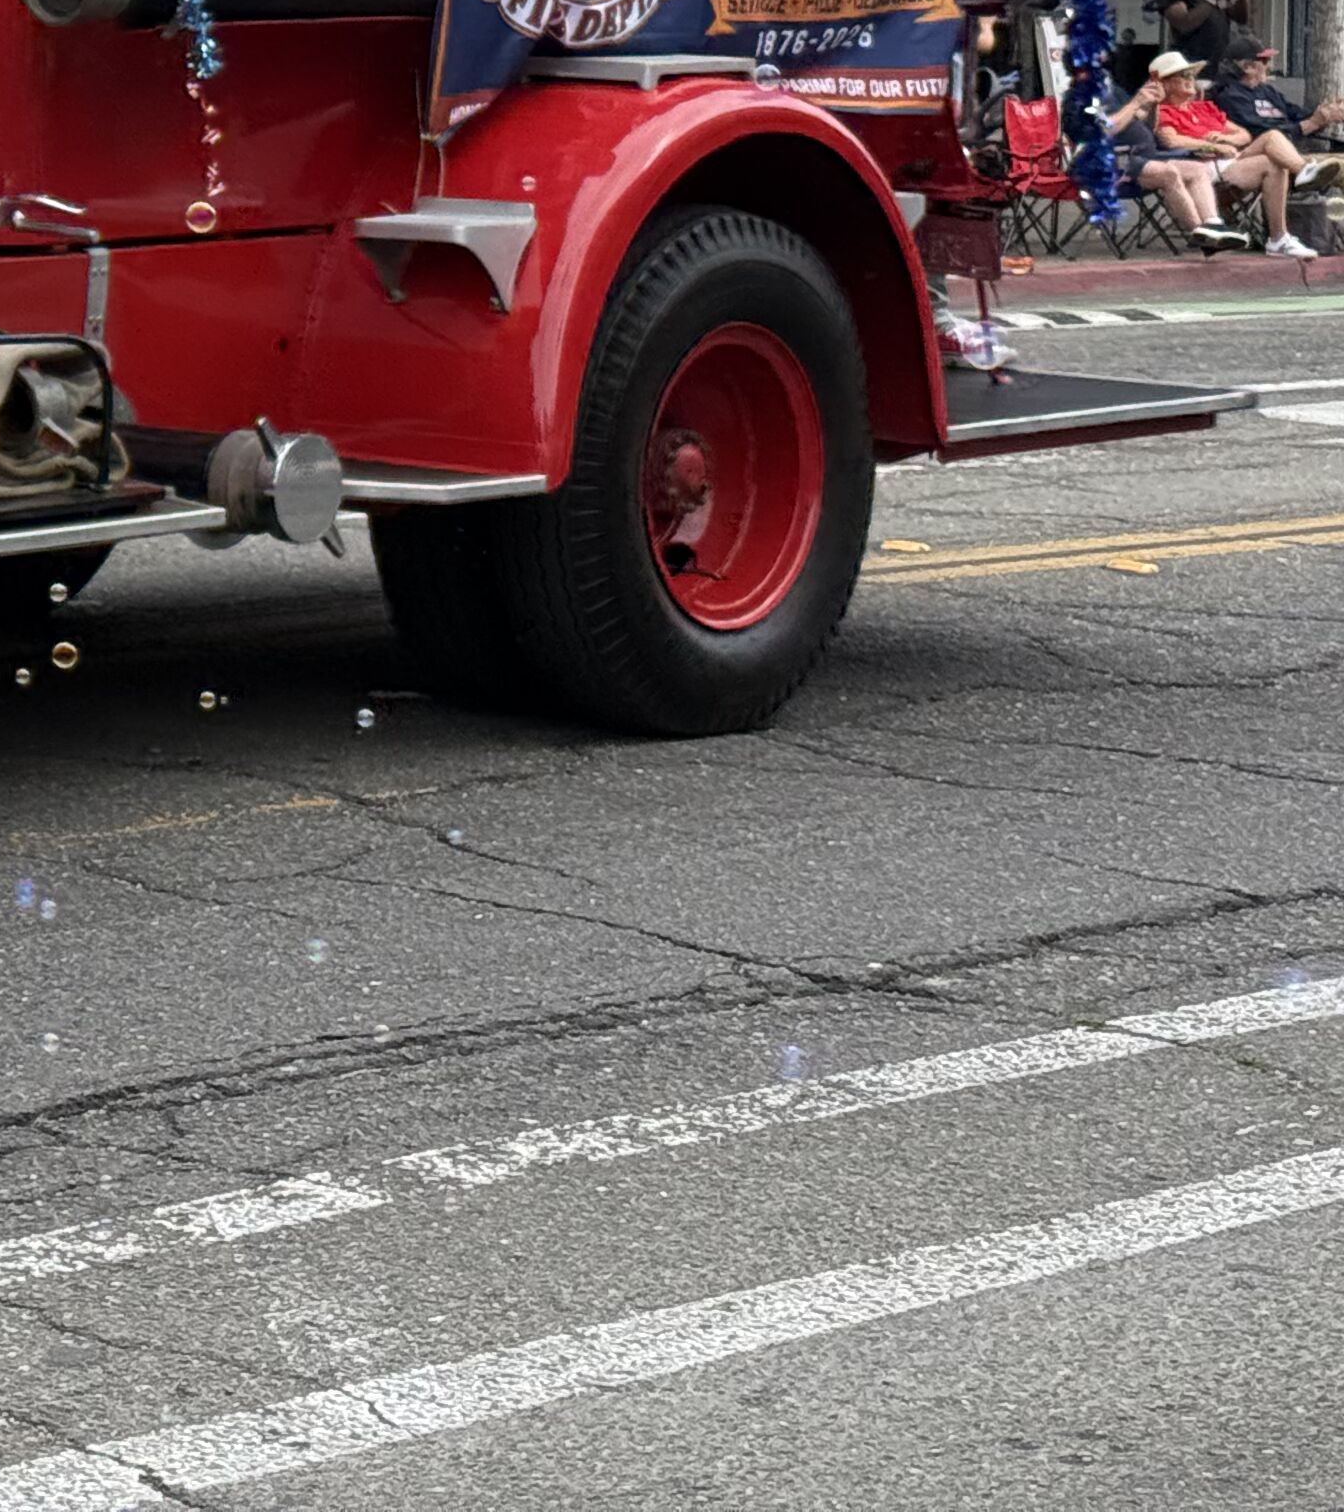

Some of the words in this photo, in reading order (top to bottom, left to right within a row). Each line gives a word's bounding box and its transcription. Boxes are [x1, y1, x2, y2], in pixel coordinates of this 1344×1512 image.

[755, 23, 875, 57] 1876-2026
[838, 78, 866, 98] FOR
[869, 79, 903, 98] OUR
